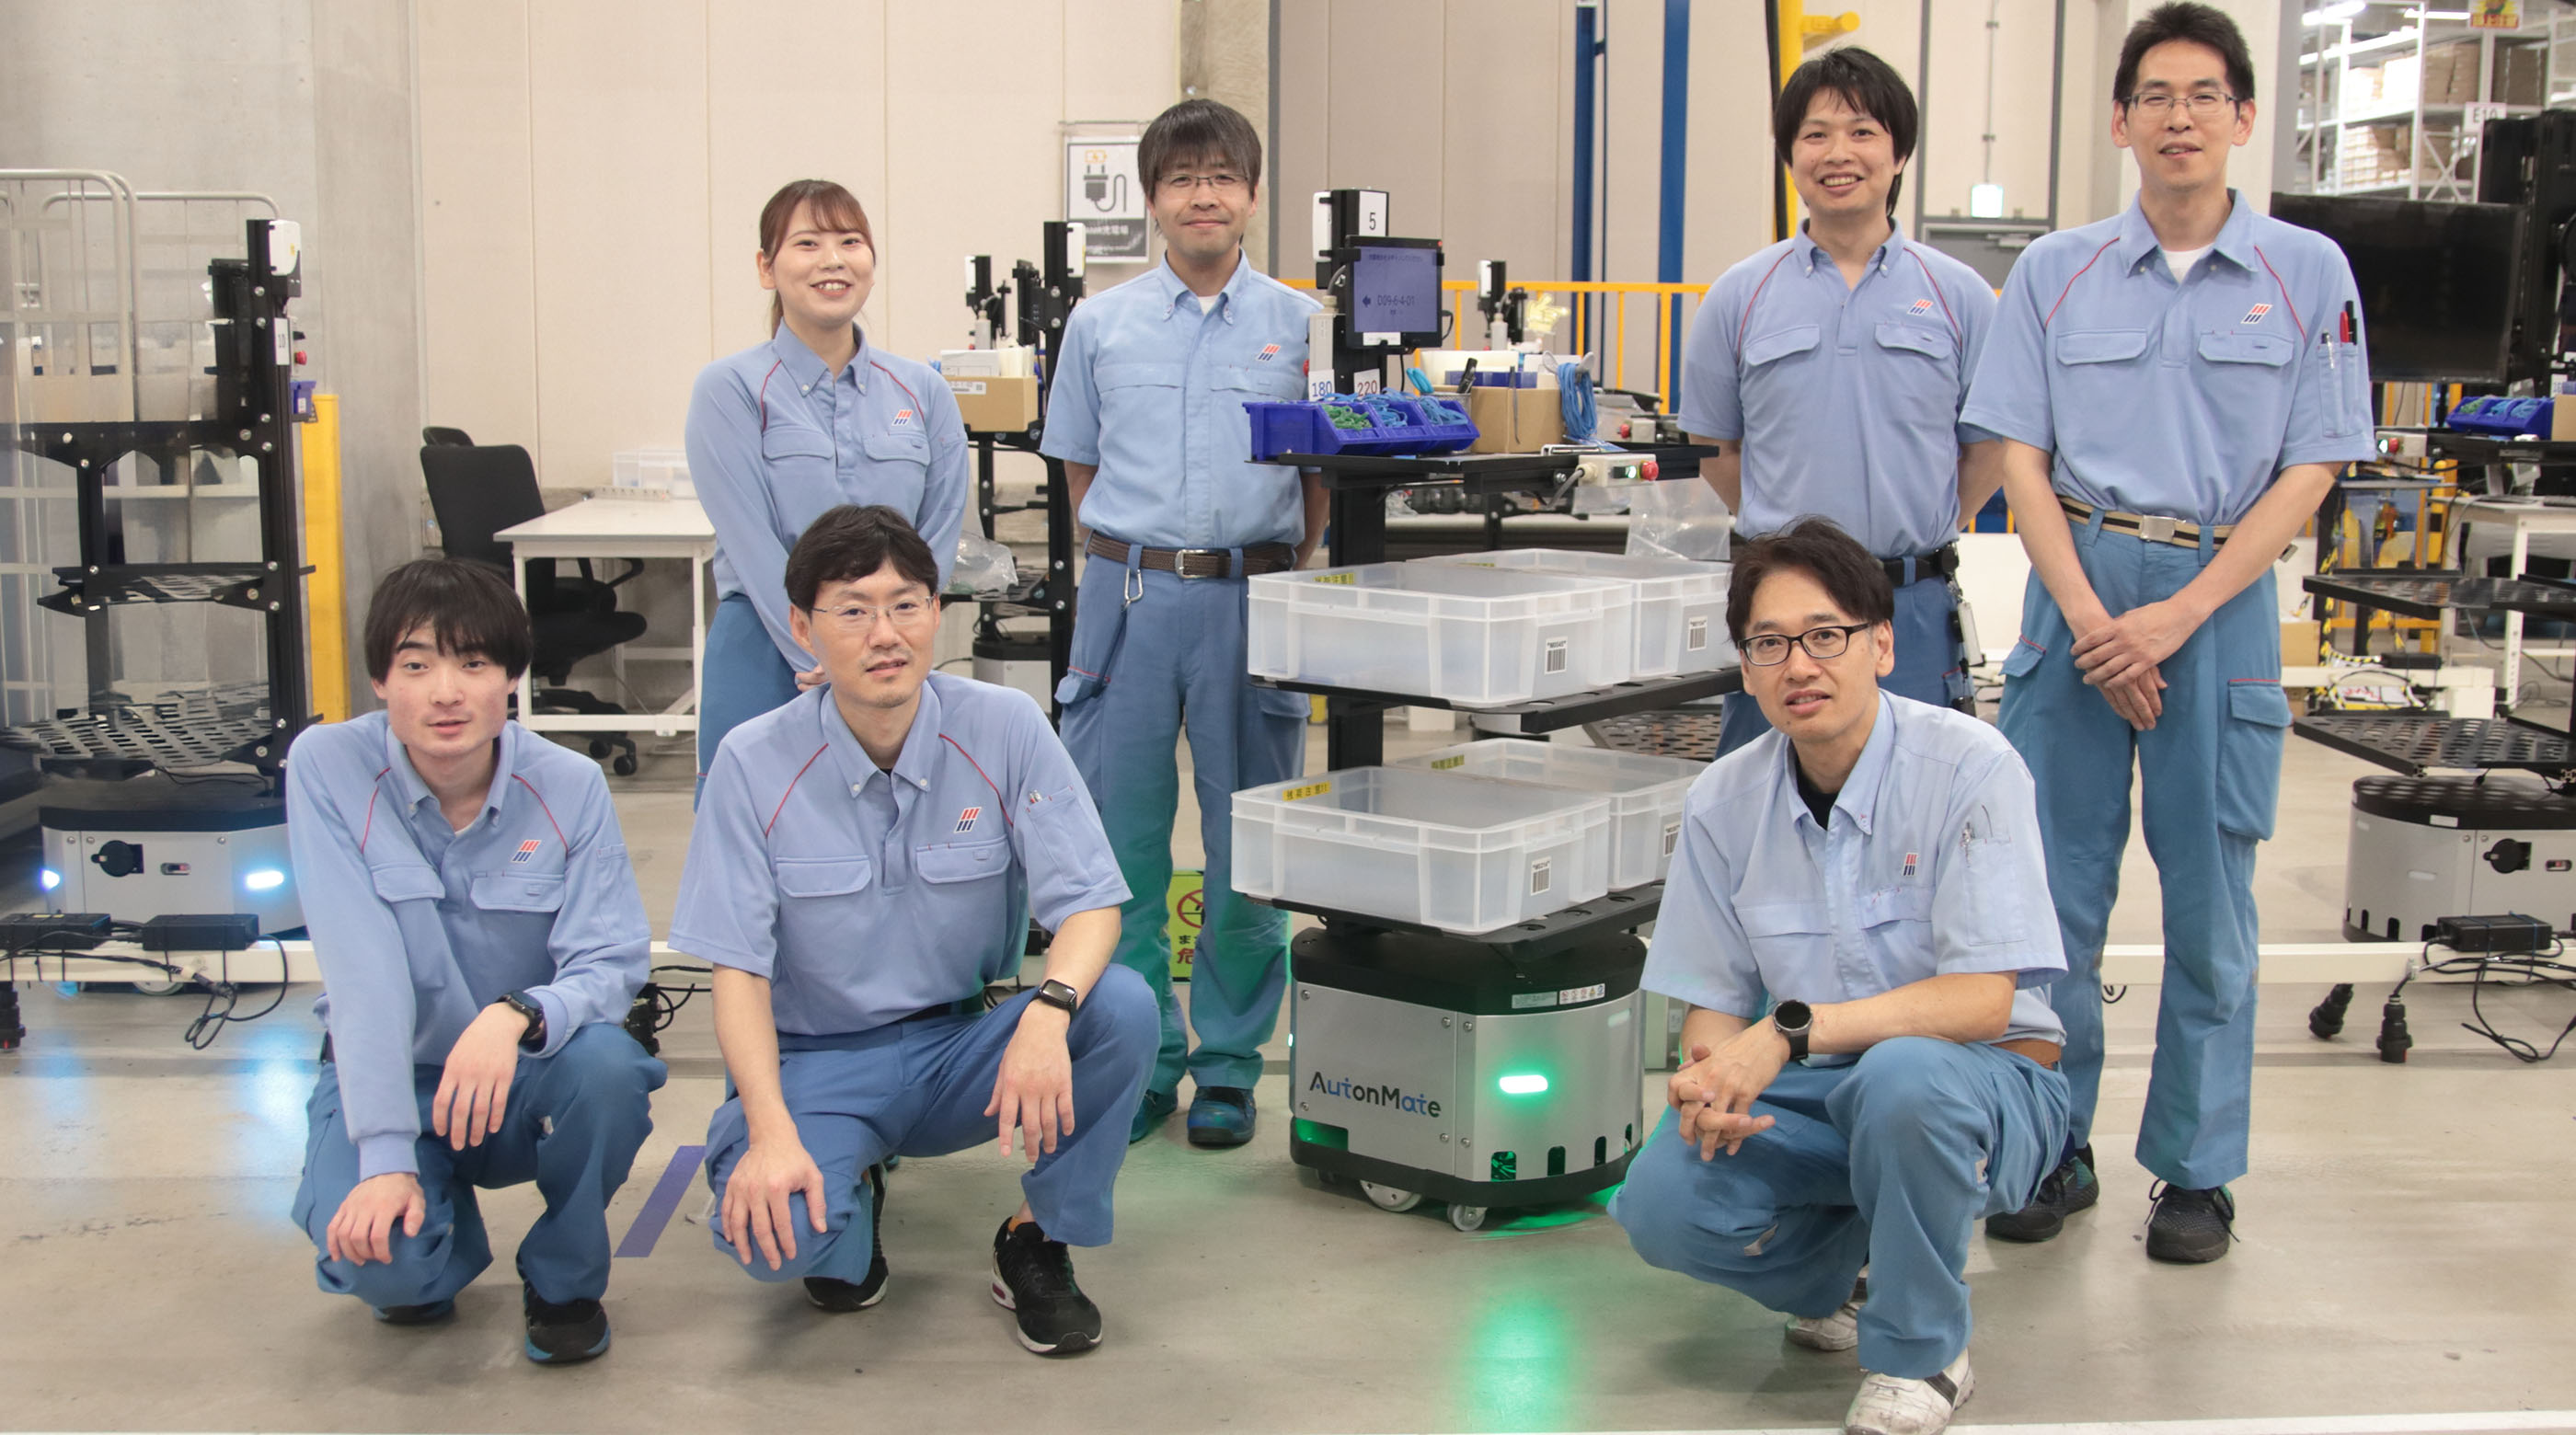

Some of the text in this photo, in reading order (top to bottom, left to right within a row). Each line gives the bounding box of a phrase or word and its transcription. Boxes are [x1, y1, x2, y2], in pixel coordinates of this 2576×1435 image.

[1369, 212, 1376, 231] 5
[1312, 380, 1333, 397] 180
[1357, 380, 1378, 396] 220
[1309, 1071, 1442, 1119] AutonMate
